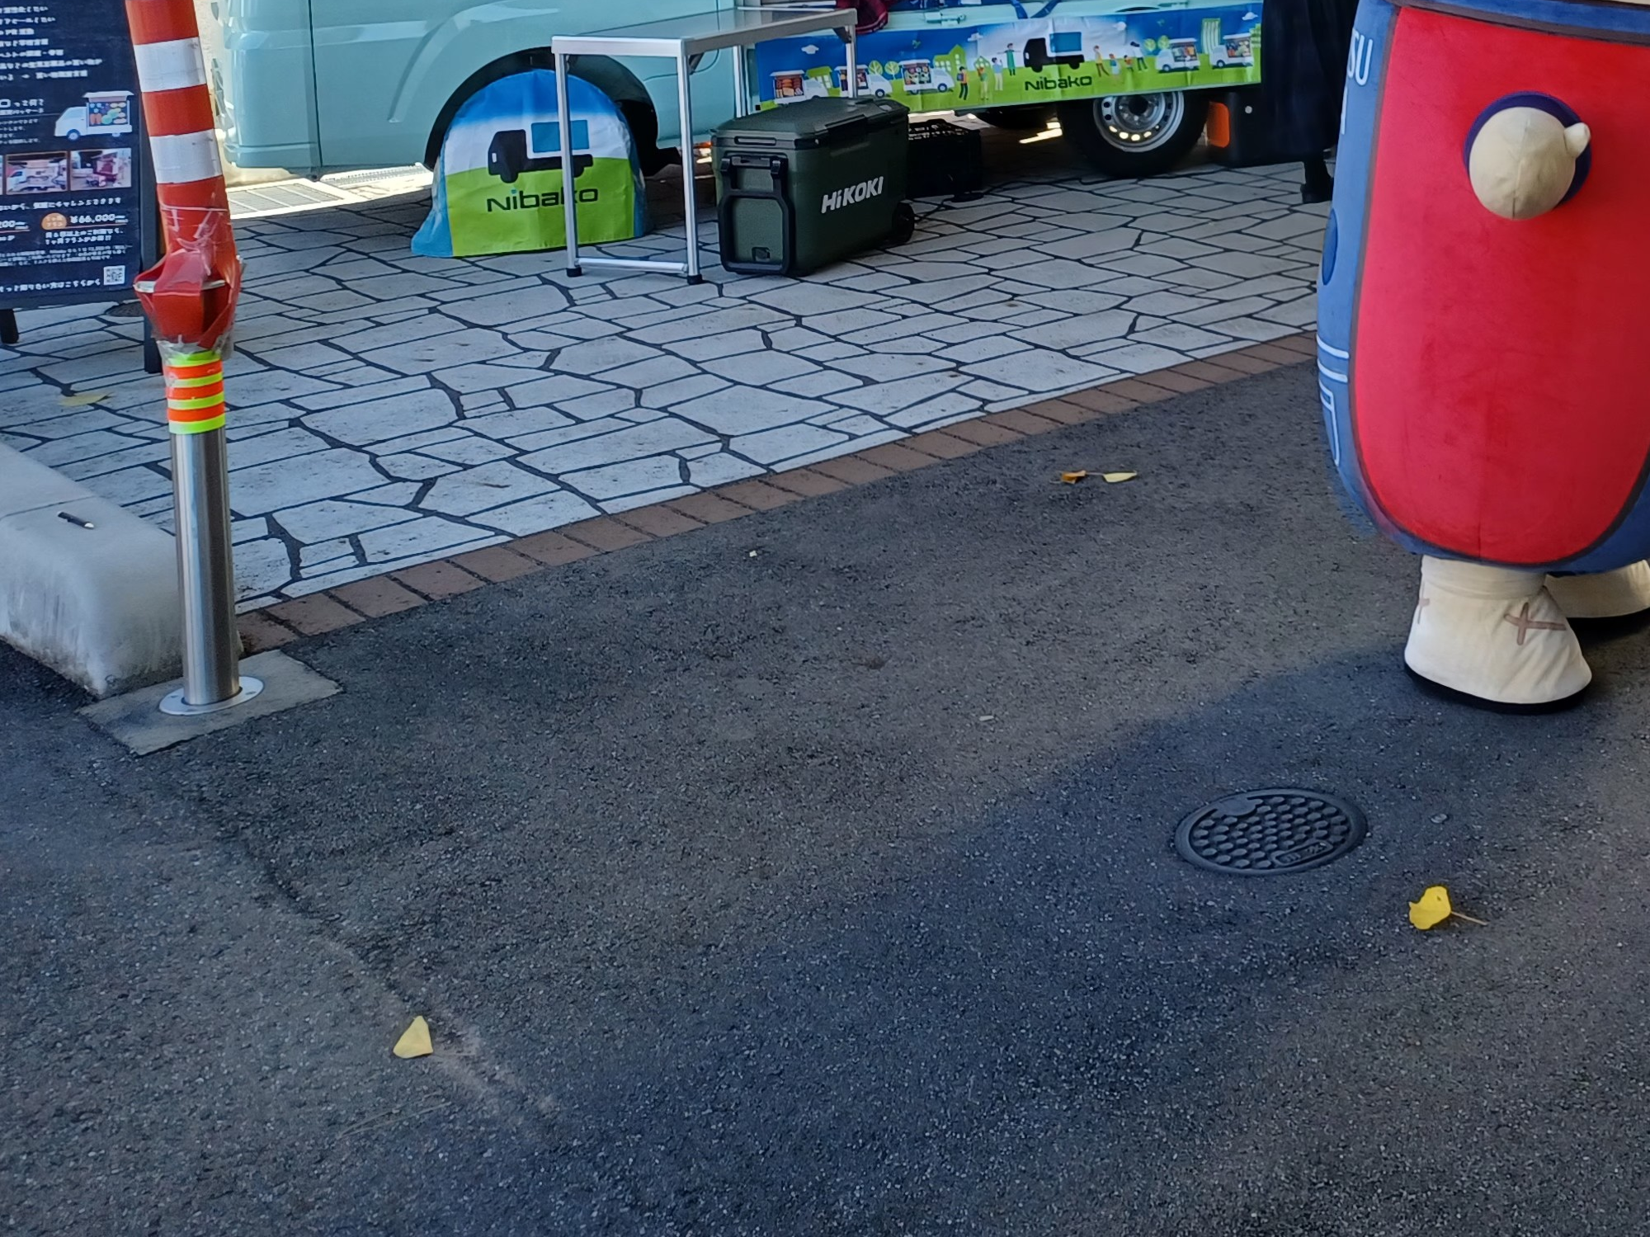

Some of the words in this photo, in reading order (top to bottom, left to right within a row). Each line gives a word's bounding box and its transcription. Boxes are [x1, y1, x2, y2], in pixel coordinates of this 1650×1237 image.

[1023, 74, 1093, 92] Nibako
[486, 186, 599, 213] Nibao
[821, 175, 884, 215] HiKOKI
